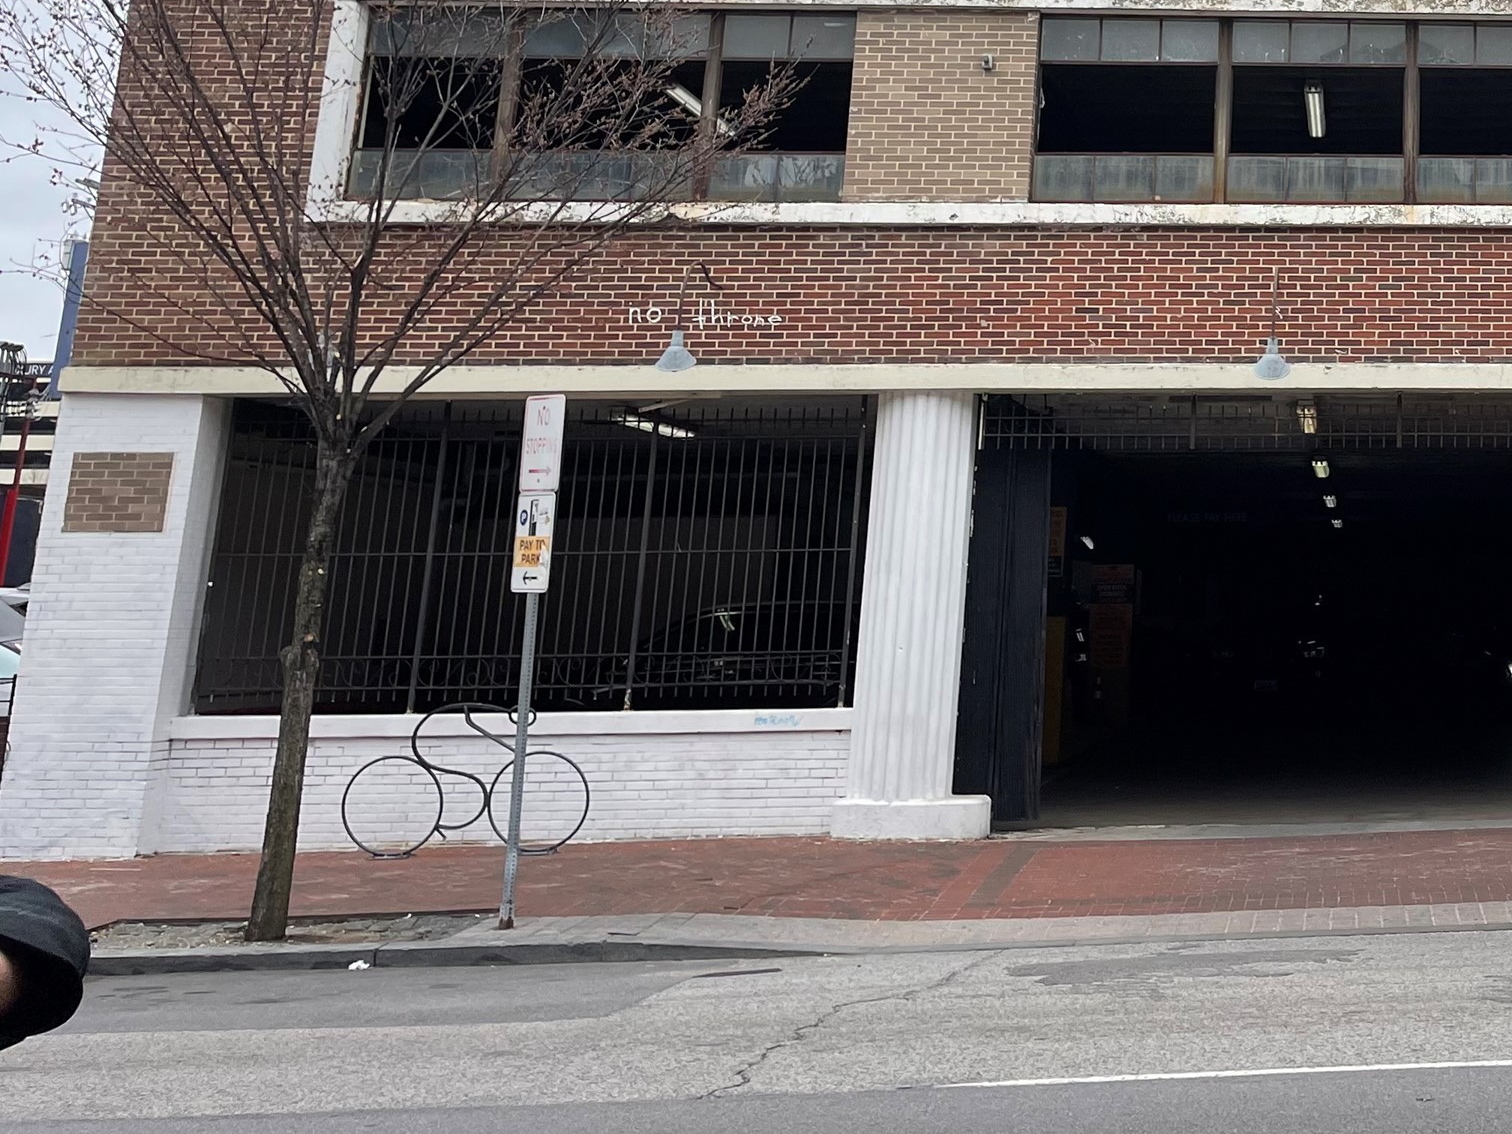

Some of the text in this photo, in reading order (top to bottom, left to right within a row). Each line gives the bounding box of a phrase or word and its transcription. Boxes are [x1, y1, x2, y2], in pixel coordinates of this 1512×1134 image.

[629, 297, 783, 330] no throne
[537, 409, 551, 426] NO
[520, 539, 534, 551] PAY
[521, 553, 542, 565] PARK
